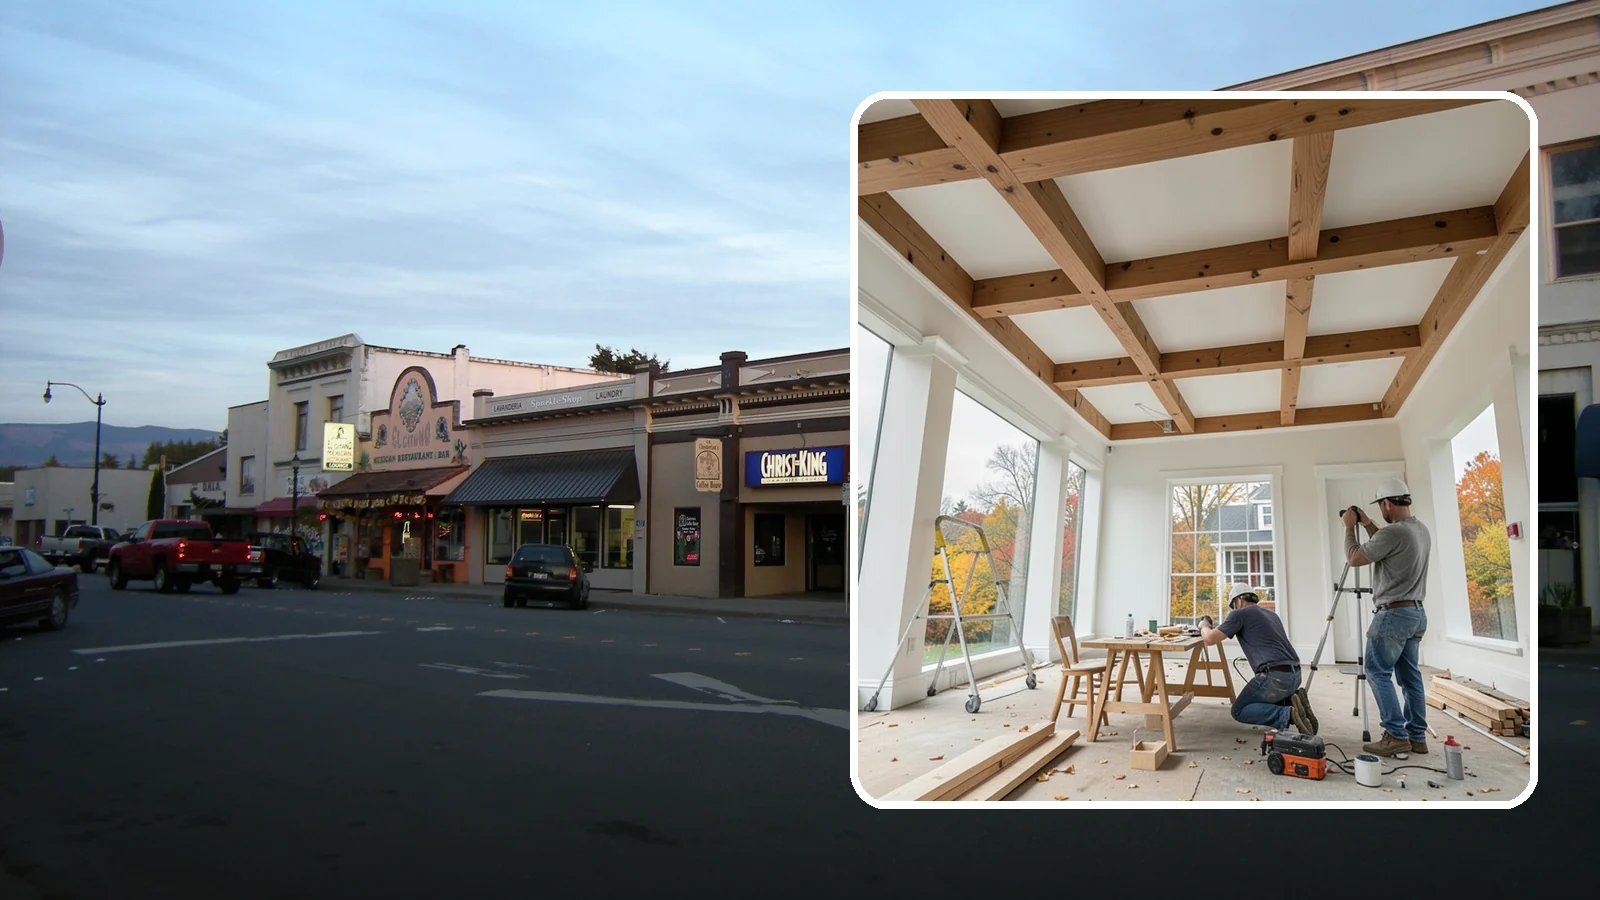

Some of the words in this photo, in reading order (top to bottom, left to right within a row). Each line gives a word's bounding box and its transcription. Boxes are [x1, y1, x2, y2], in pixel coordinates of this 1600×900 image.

[493, 402, 523, 412] LAVANDERIA
[595, 389, 623, 400] LAUNDRY
[374, 454, 396, 464] MEXICAN
[397, 451, 433, 462] RESTAURANT
[438, 450, 450, 459] BAR
